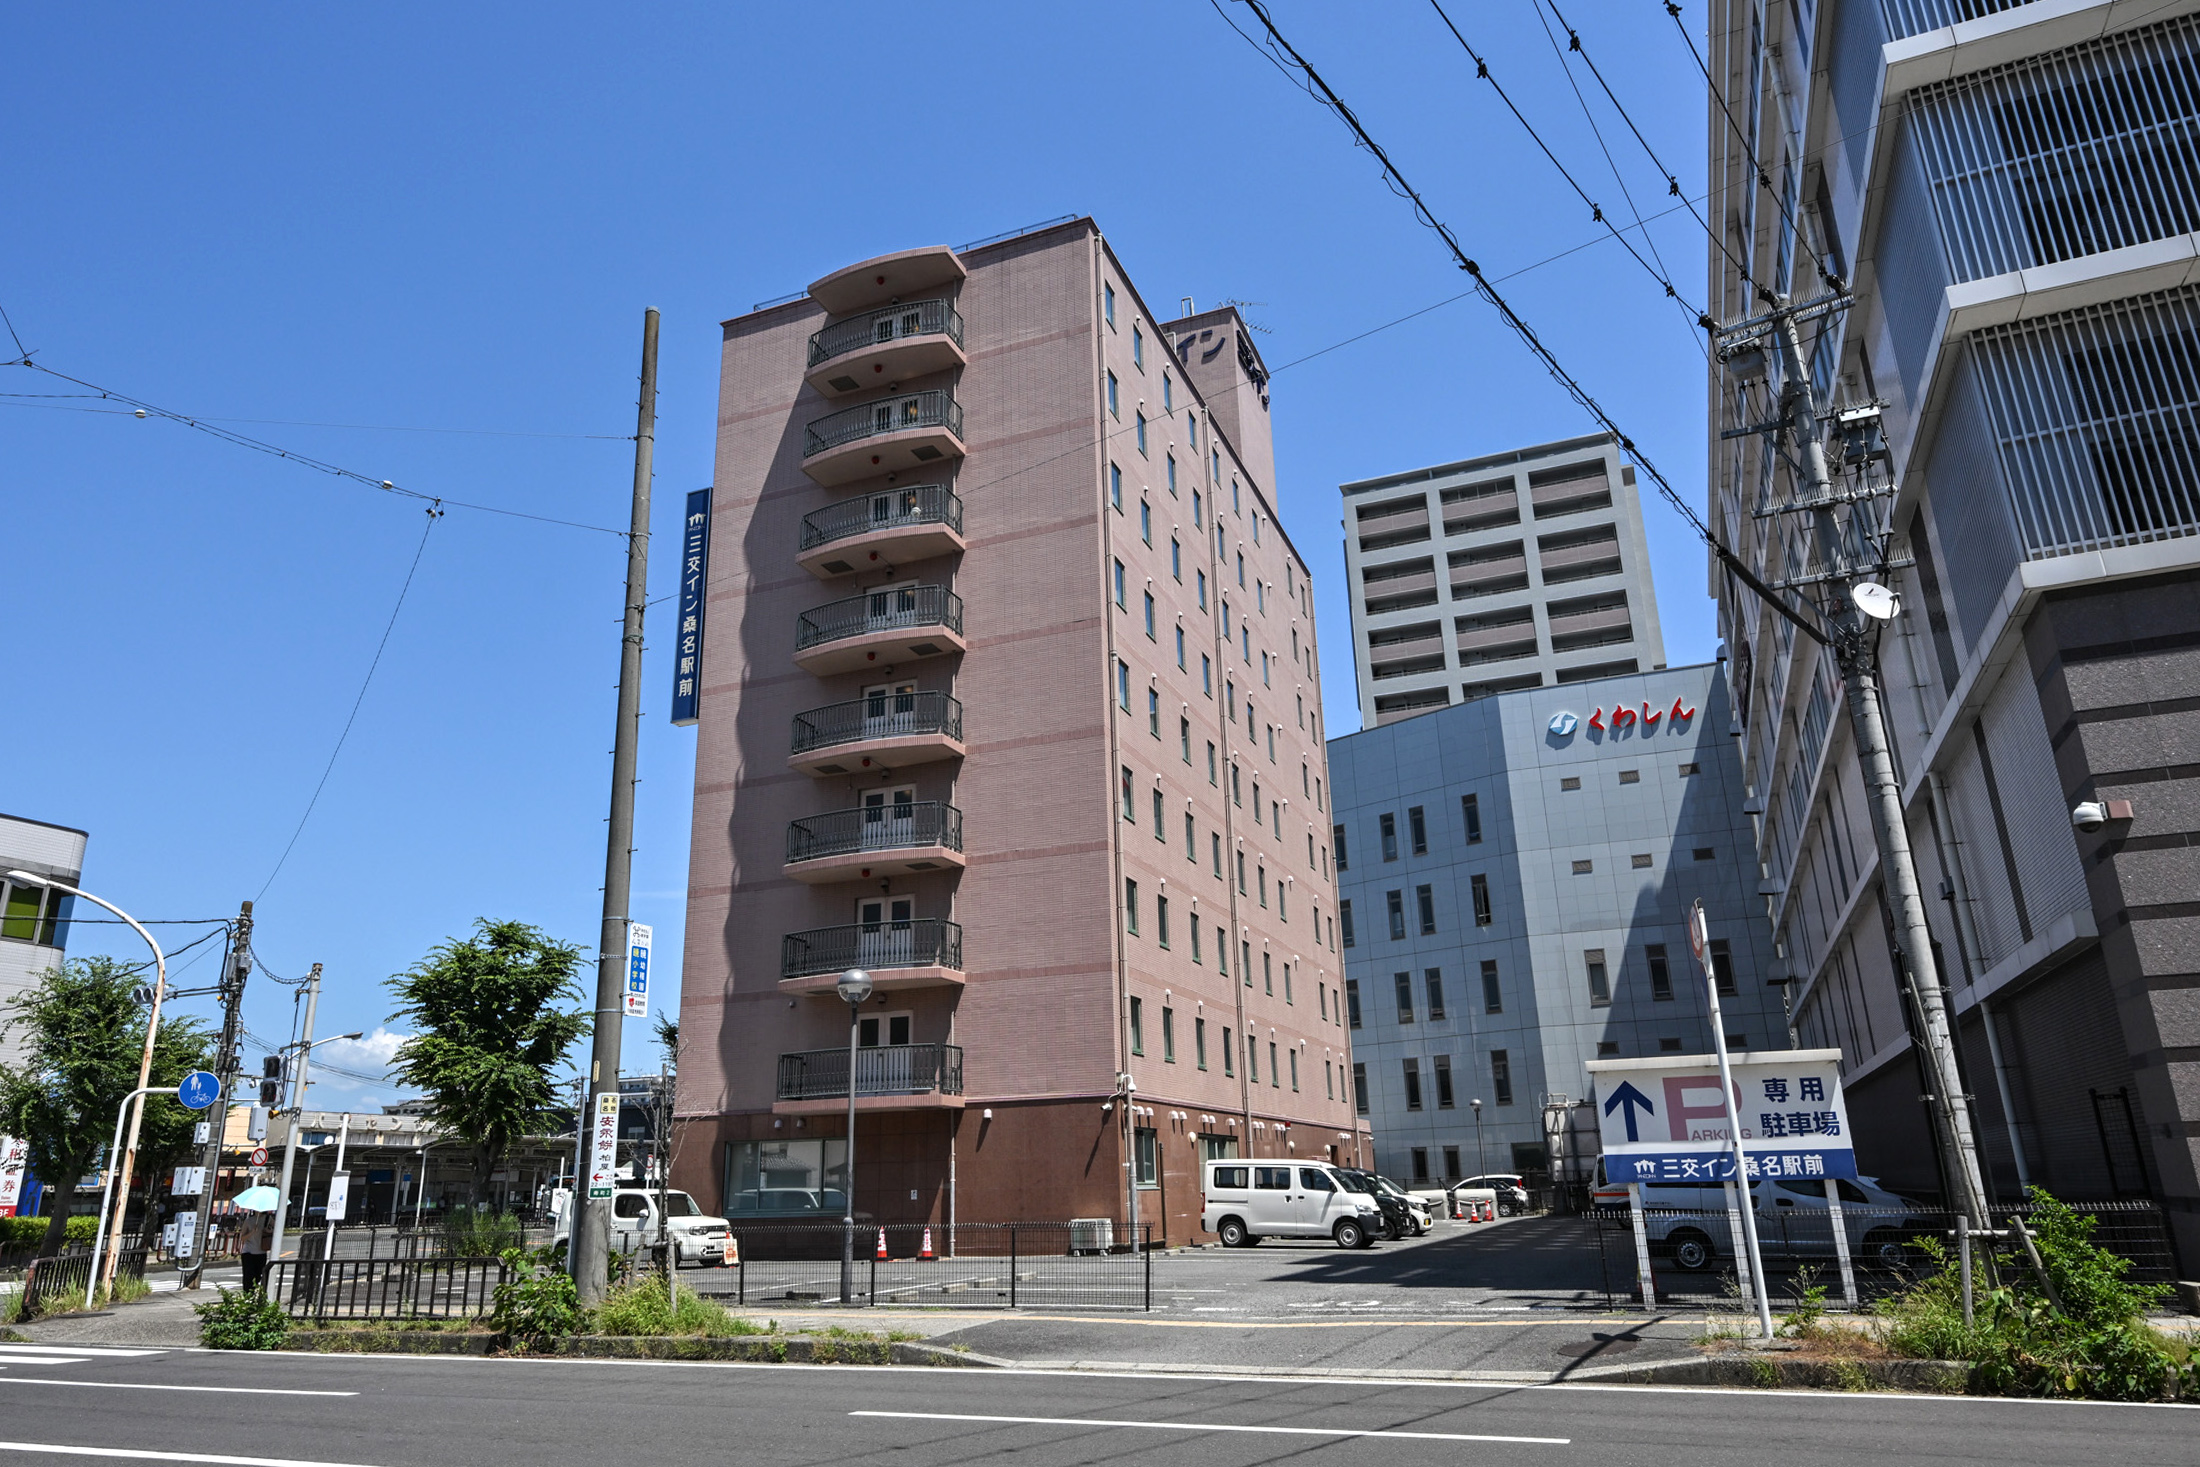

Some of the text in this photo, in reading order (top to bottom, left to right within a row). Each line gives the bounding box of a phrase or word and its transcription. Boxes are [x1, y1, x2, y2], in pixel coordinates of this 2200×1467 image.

[678, 534, 703, 698] 三交イン桑名駅前
[1589, 697, 1695, 730] くわしん
[1762, 1076, 1825, 1103] 専用
[1760, 1111, 1840, 1138] 駐車場
[1662, 1154, 1825, 1179] 三交イン桑名駅前
